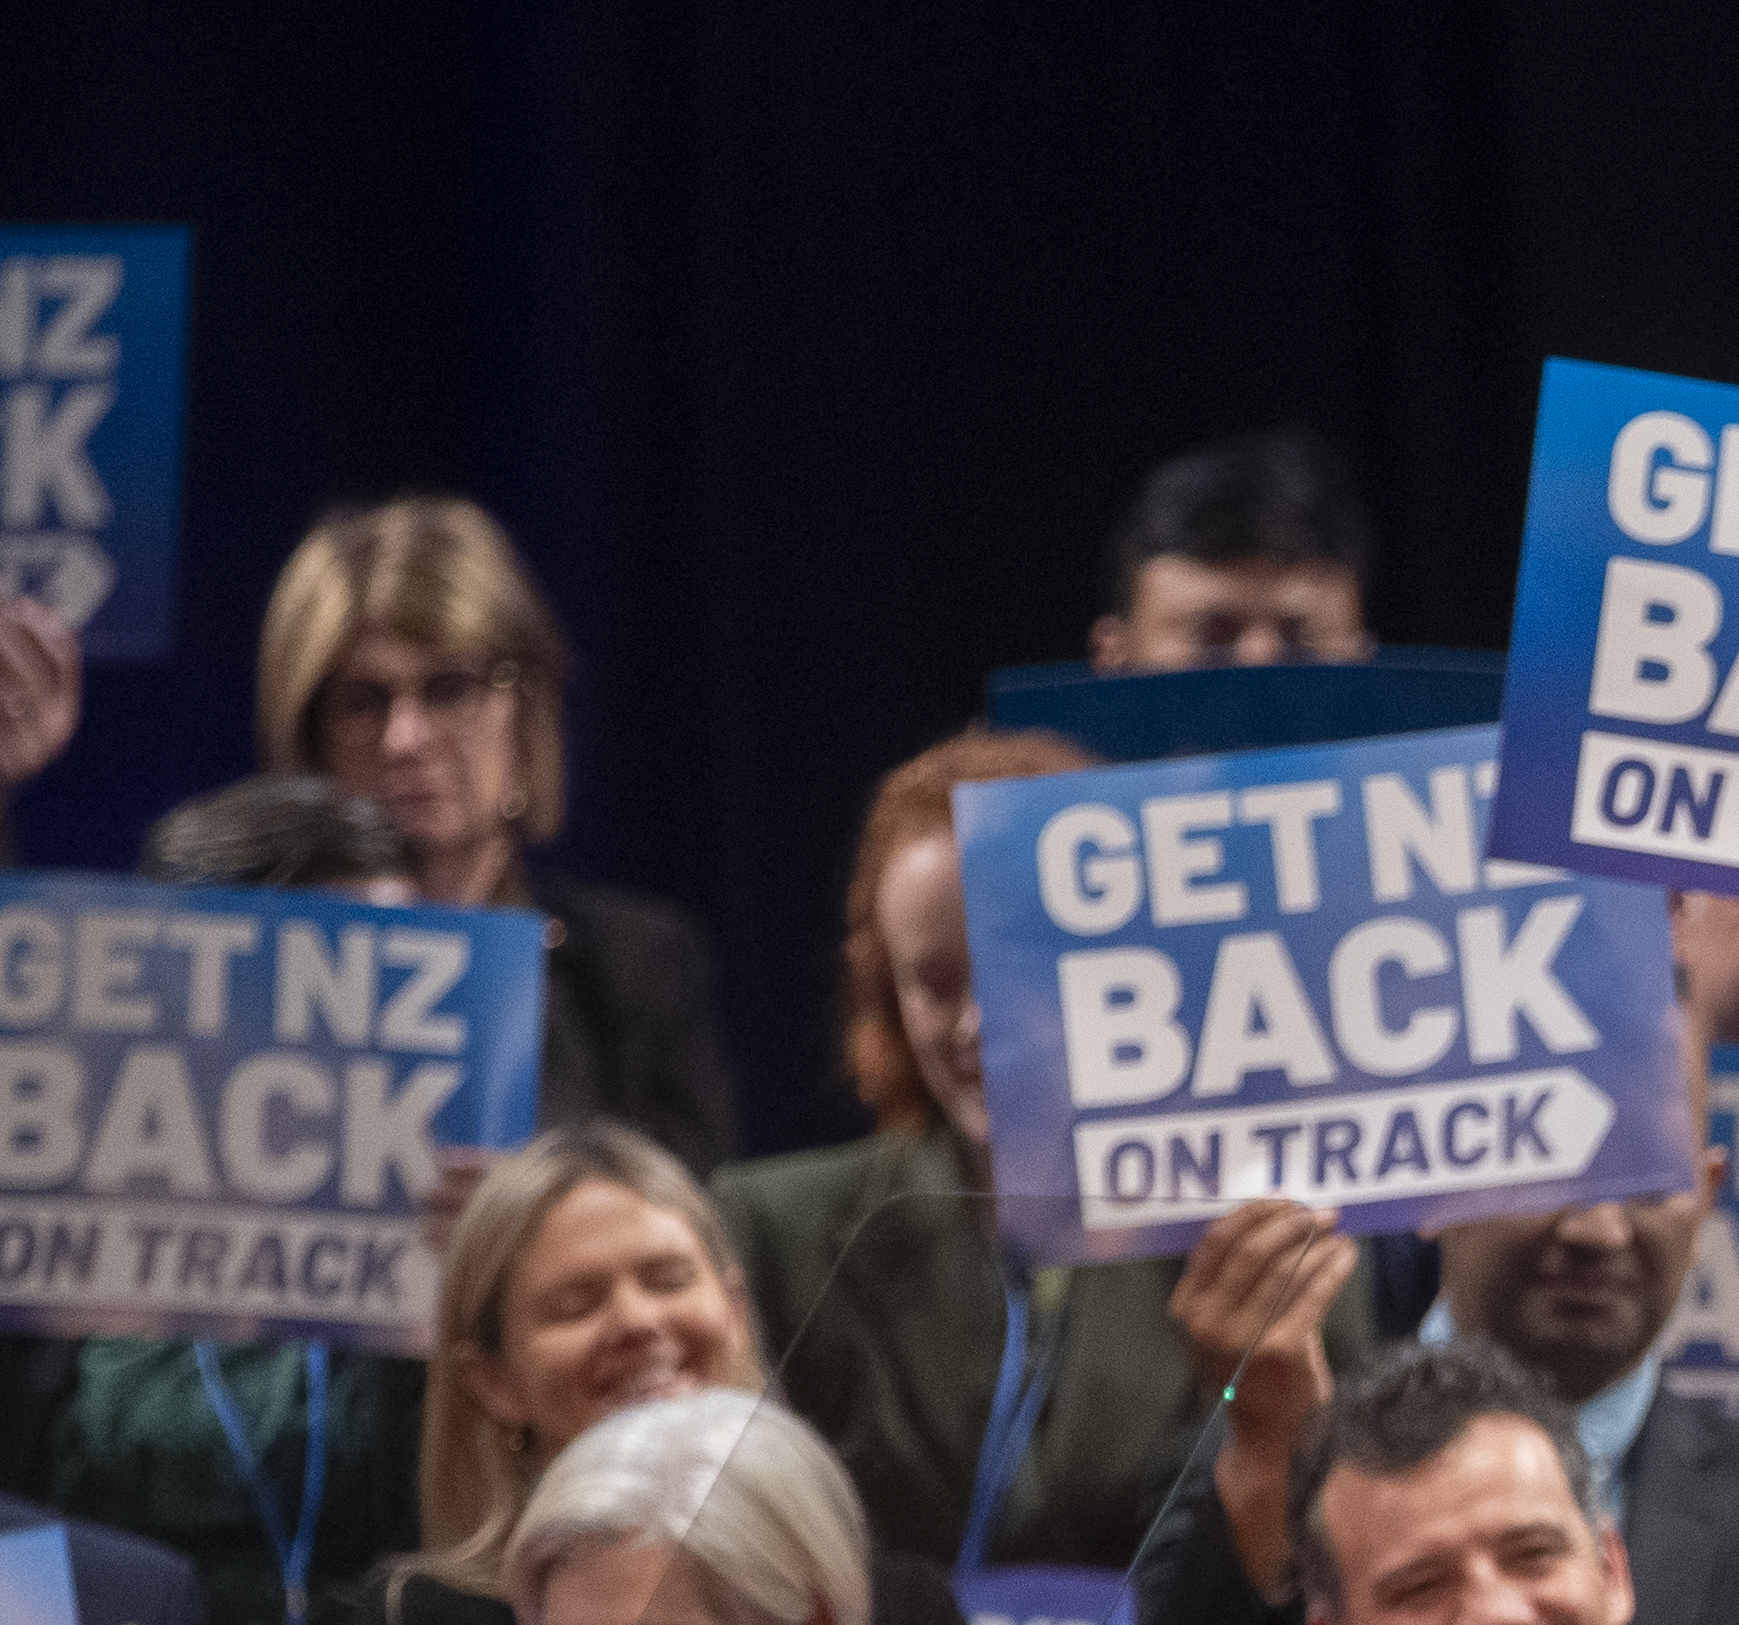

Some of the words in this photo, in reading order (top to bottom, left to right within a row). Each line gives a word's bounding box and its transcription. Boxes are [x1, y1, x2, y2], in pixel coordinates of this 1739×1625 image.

[1036, 778, 1342, 936] GET
[1596, 756, 1725, 841] ON
[0, 908, 259, 1040] GET
[274, 918, 472, 1057] NZ
[1056, 894, 1600, 1111] BACK
[0, 1040, 463, 1208] BACK
[1104, 1130, 1224, 1205] ON
[1252, 1088, 1560, 1194] TRACK
[127, 1225, 397, 1300] TRACK
